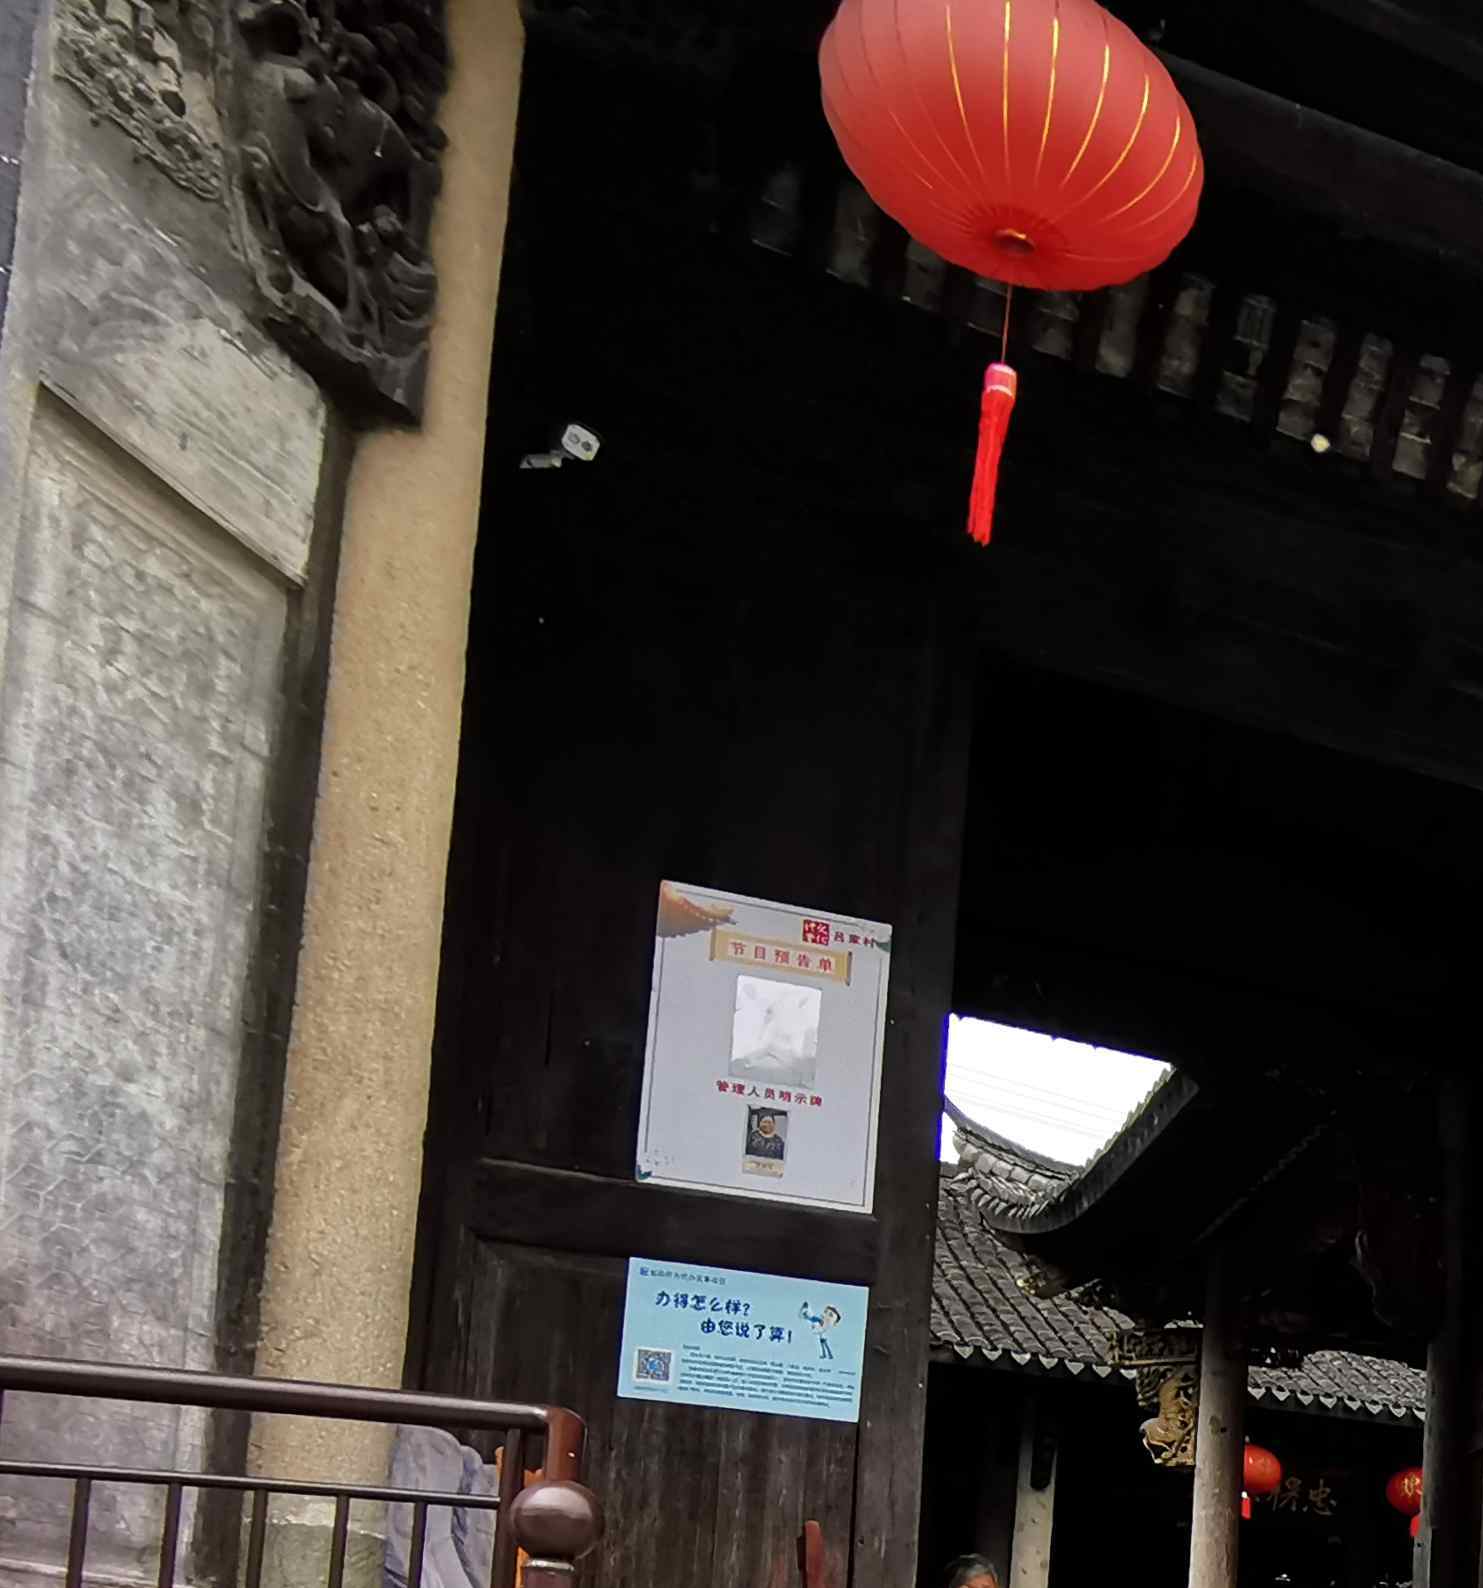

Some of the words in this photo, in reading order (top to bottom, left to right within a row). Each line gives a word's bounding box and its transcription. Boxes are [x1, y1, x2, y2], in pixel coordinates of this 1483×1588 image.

[728, 941, 834, 973] 节目预告单
[715, 1080, 823, 1107] 管理人员明示牌
[699, 1317, 793, 1344] 由您说了算!
